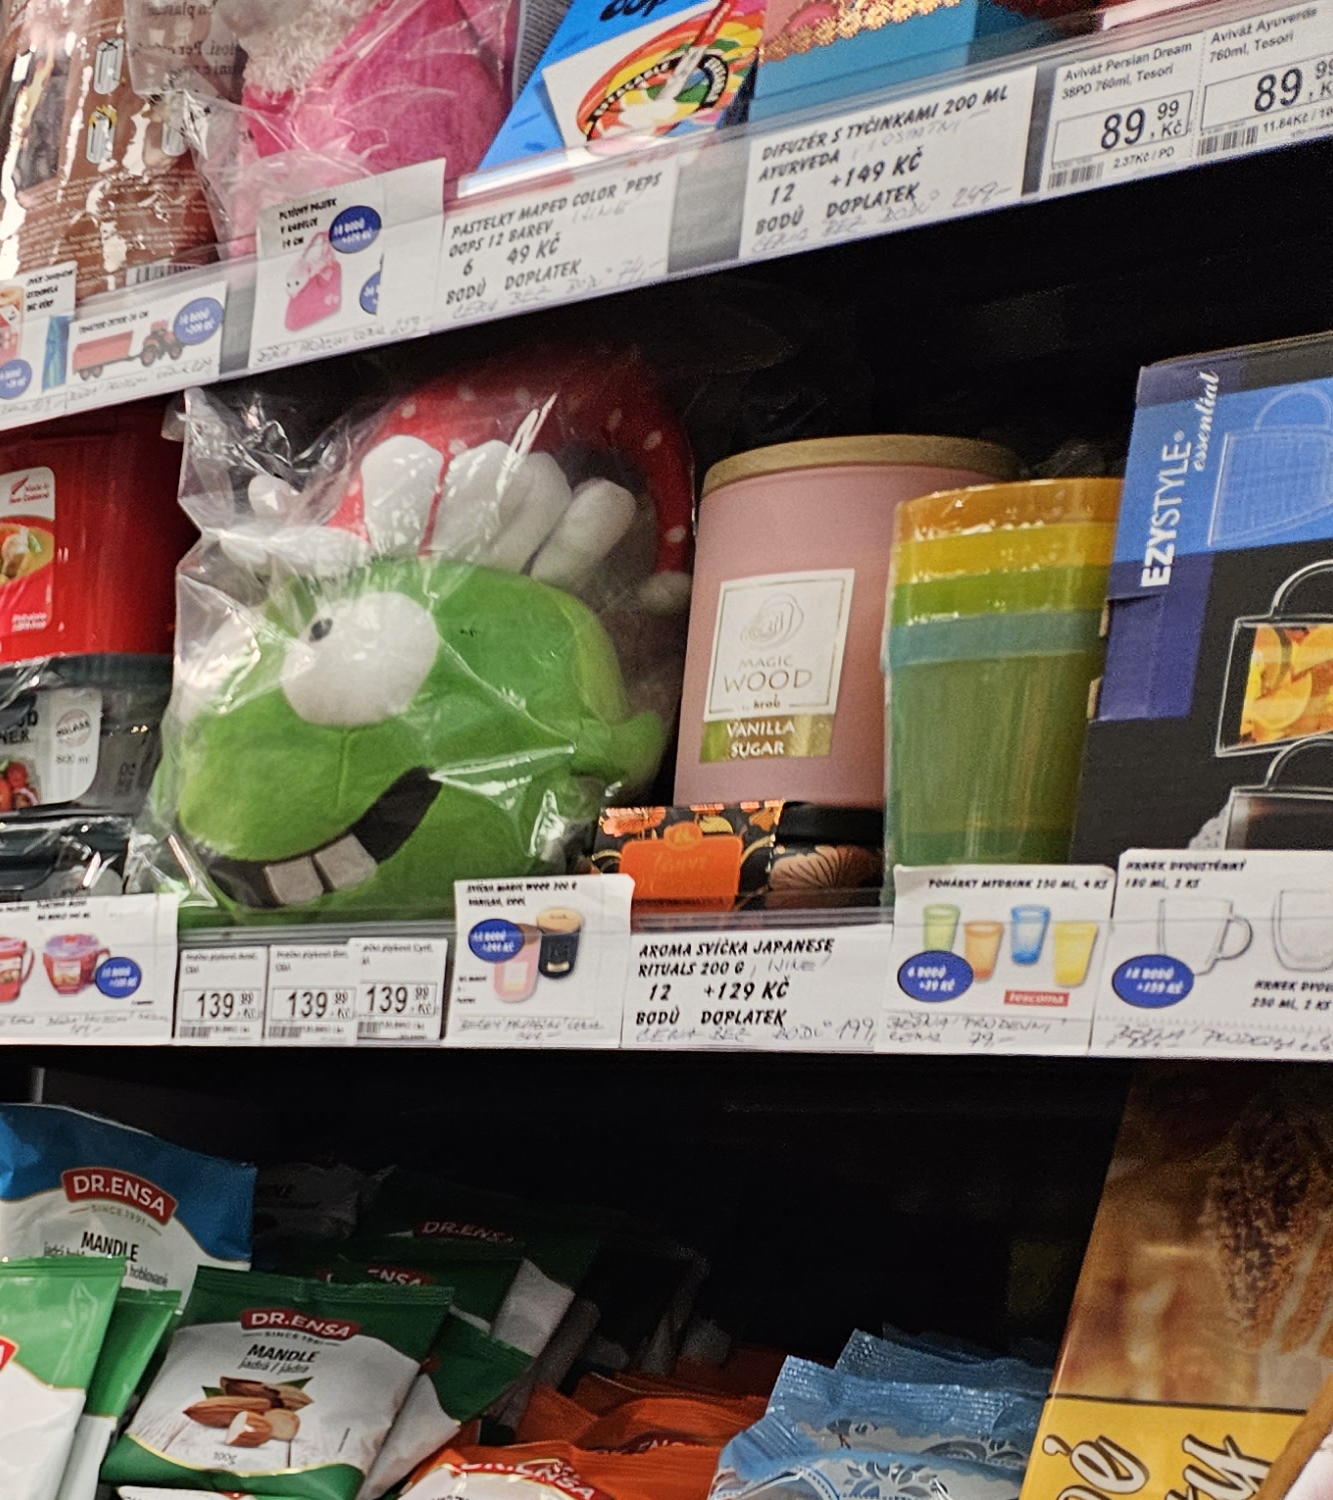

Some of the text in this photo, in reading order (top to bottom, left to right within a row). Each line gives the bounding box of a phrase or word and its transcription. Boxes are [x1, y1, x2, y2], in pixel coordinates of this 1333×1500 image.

[1105, 53, 1151, 74] Persian
[1153, 42, 1193, 60] Dream
[1254, 33, 1295, 52] Tesori
[1137, 64, 1175, 82] Tesori
[761, 84, 1009, 162] DIFUZÉR TYČINKAMI 200 ML
[758, 150, 841, 184] AYURVEDA
[770, 144, 924, 206] 12 +149 KČ
[450, 183, 619, 240] PASTELKY MAPED COLOR
[755, 181, 921, 237] BODŮ DOPLATEK
[448, 218, 554, 259] OOPS 12 BAREV
[462, 257, 475, 278] 6
[535, 230, 562, 261] KČ
[445, 276, 488, 306] BODŮ
[504, 258, 583, 292] DOPLATEK
[1192, 369, 1221, 472] essential
[1140, 440, 1194, 588] EZYSTYLE
[737, 653, 795, 673] MAGIC
[723, 668, 814, 695] WOOD
[726, 719, 797, 739] VANILLA
[730, 740, 785, 759] SUGAR
[639, 937, 836, 959] AROMA SVÍČKA JAPANESE
[637, 960, 746, 978] RITUALS 200 G
[648, 974, 791, 1002] 12 +129 KČ
[635, 1004, 788, 1027] BODŮ DOPLATEK
[71, 1172, 167, 1219] DR.ENSA
[80, 1230, 140, 1264] MANDLE
[250, 1311, 353, 1340] DR.ENSA
[247, 1343, 321, 1364] MANDLE
